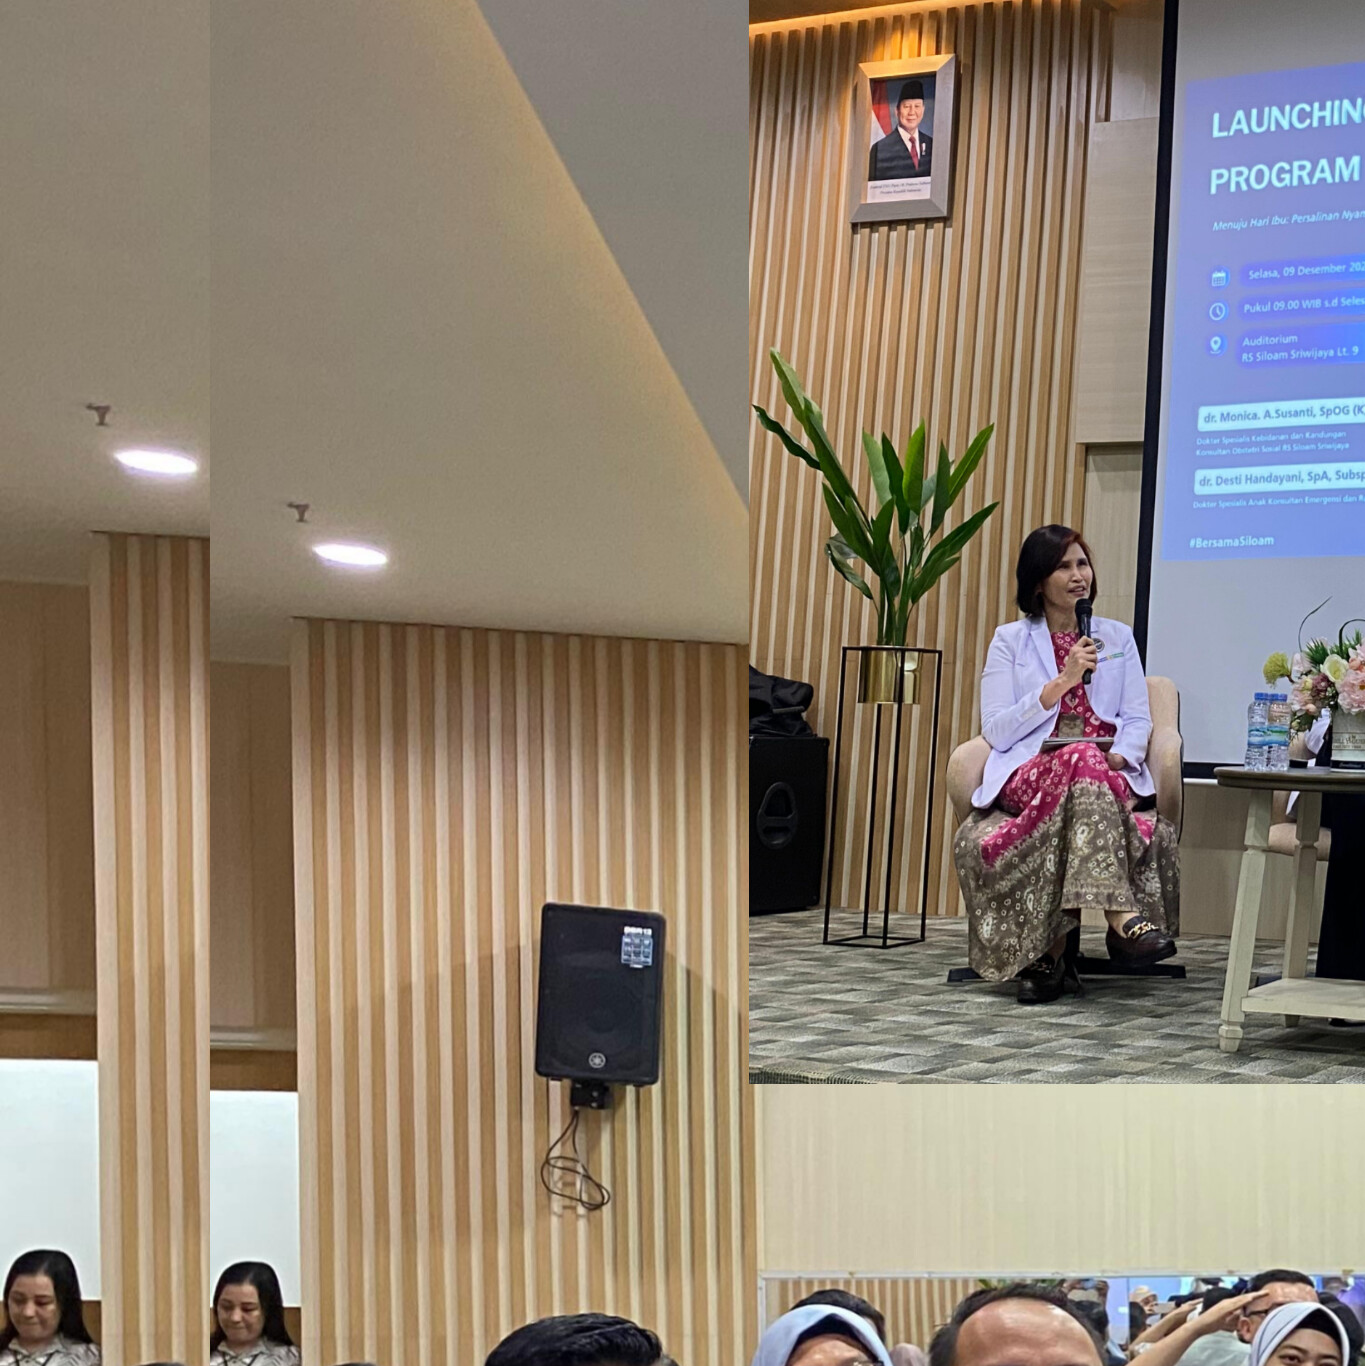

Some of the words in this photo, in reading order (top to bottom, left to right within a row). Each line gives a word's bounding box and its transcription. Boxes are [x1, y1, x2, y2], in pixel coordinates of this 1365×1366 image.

[1210, 155, 1361, 195] PROGRAM
[1213, 219, 1247, 232] Menuju
[1250, 216, 1269, 228] Hari
[1271, 214, 1289, 226] Ibu:
[1291, 211, 1339, 224] Persalinan
[1248, 269, 1280, 280] Selasa,
[1283, 267, 1295, 277] 09
[1298, 264, 1346, 276] Desember
[1243, 302, 1271, 313] Pukul
[1273, 301, 1299, 311] 09.00
[1301, 298, 1322, 309] WIB
[1324, 297, 1338, 308] s.d
[1242, 335, 1298, 347] Auditorium
[1241, 352, 1254, 363] RS
[1256, 350, 1288, 361] Siloam
[1290, 347, 1335, 360] Sriwijaya
[1337, 347, 1349, 356] Lt.
[1352, 346, 1359, 356] 9
[1204, 413, 1217, 424] dr.
[1220, 411, 1261, 423] Monica.
[1263, 406, 1316, 420] A.Susanti,
[1320, 405, 1350, 418] SpOG
[1199, 477, 1212, 487] dr.
[1216, 475, 1242, 486] Desti
[1245, 471, 1304, 485] Handayani,
[1307, 471, 1332, 483] SpA,
[1189, 535, 1274, 548] #BersamaSiloam
